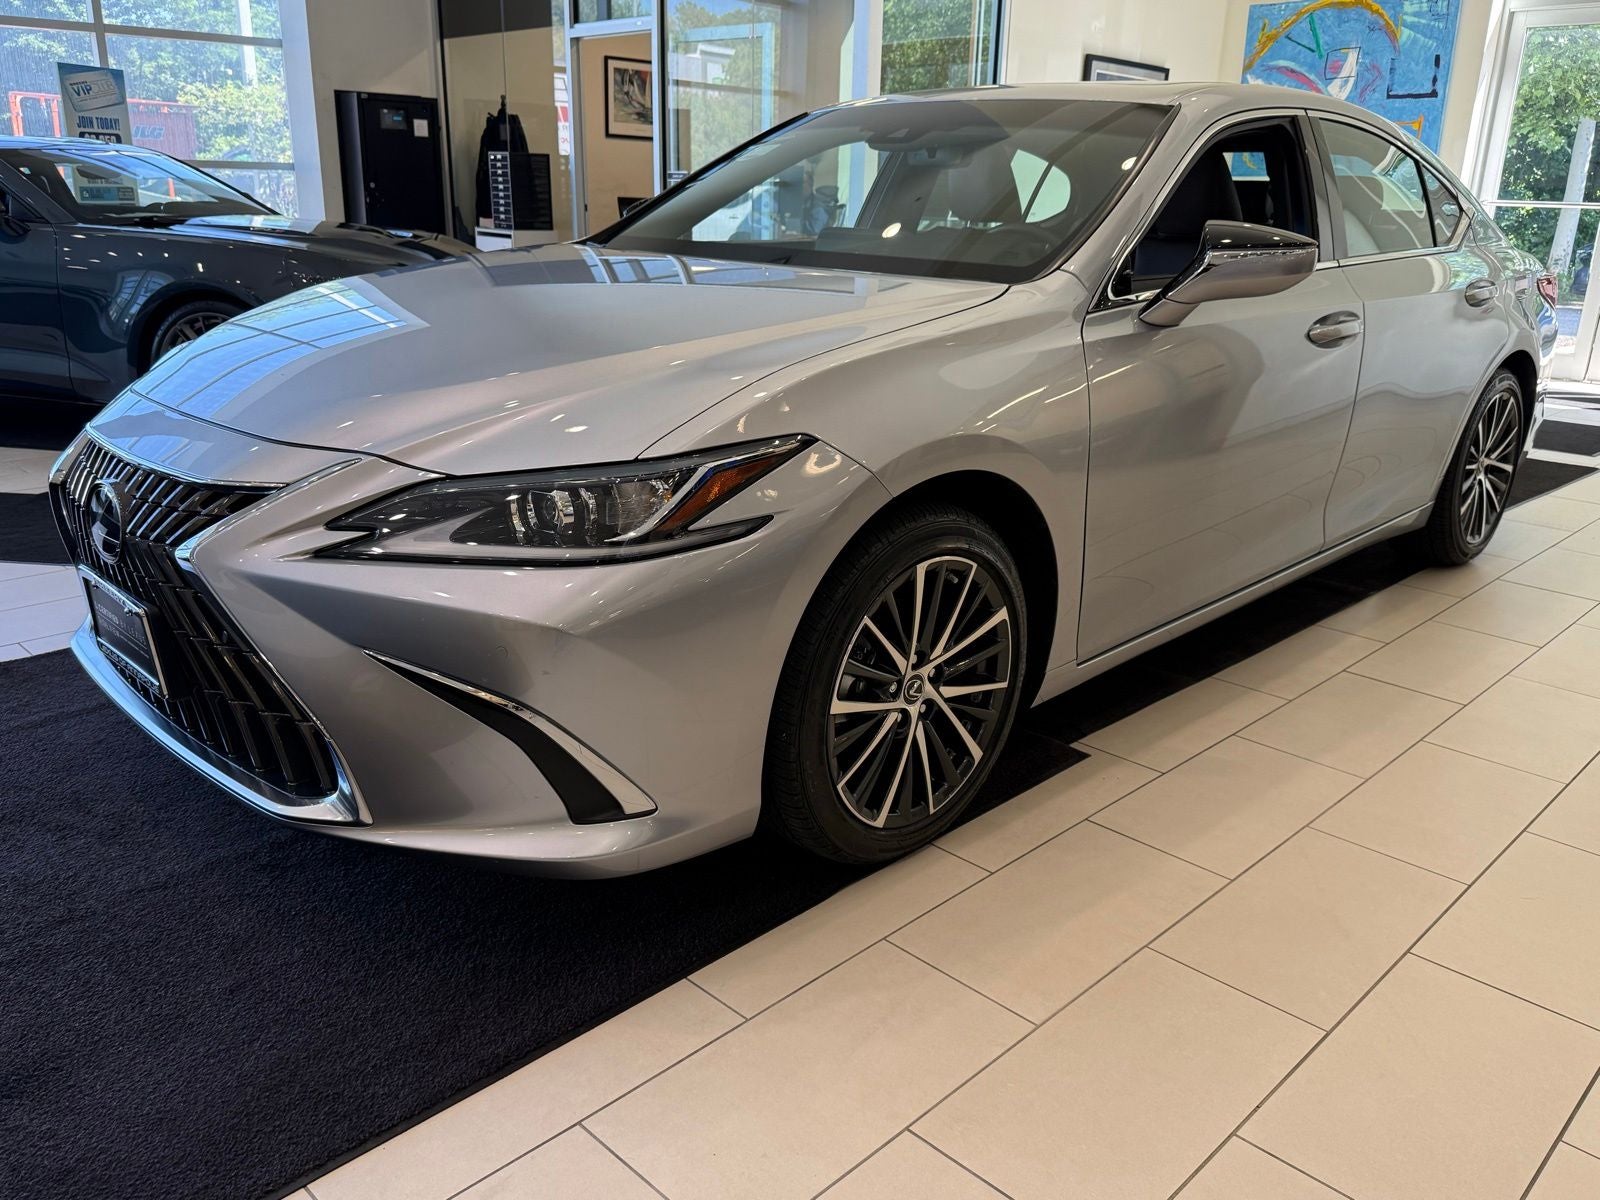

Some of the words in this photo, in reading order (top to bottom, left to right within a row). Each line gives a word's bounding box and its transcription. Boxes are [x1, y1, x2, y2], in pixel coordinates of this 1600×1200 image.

[71, 84, 92, 97] VIP
[77, 116, 95, 129] JOIN
[96, 117, 120, 130] TODAY!
